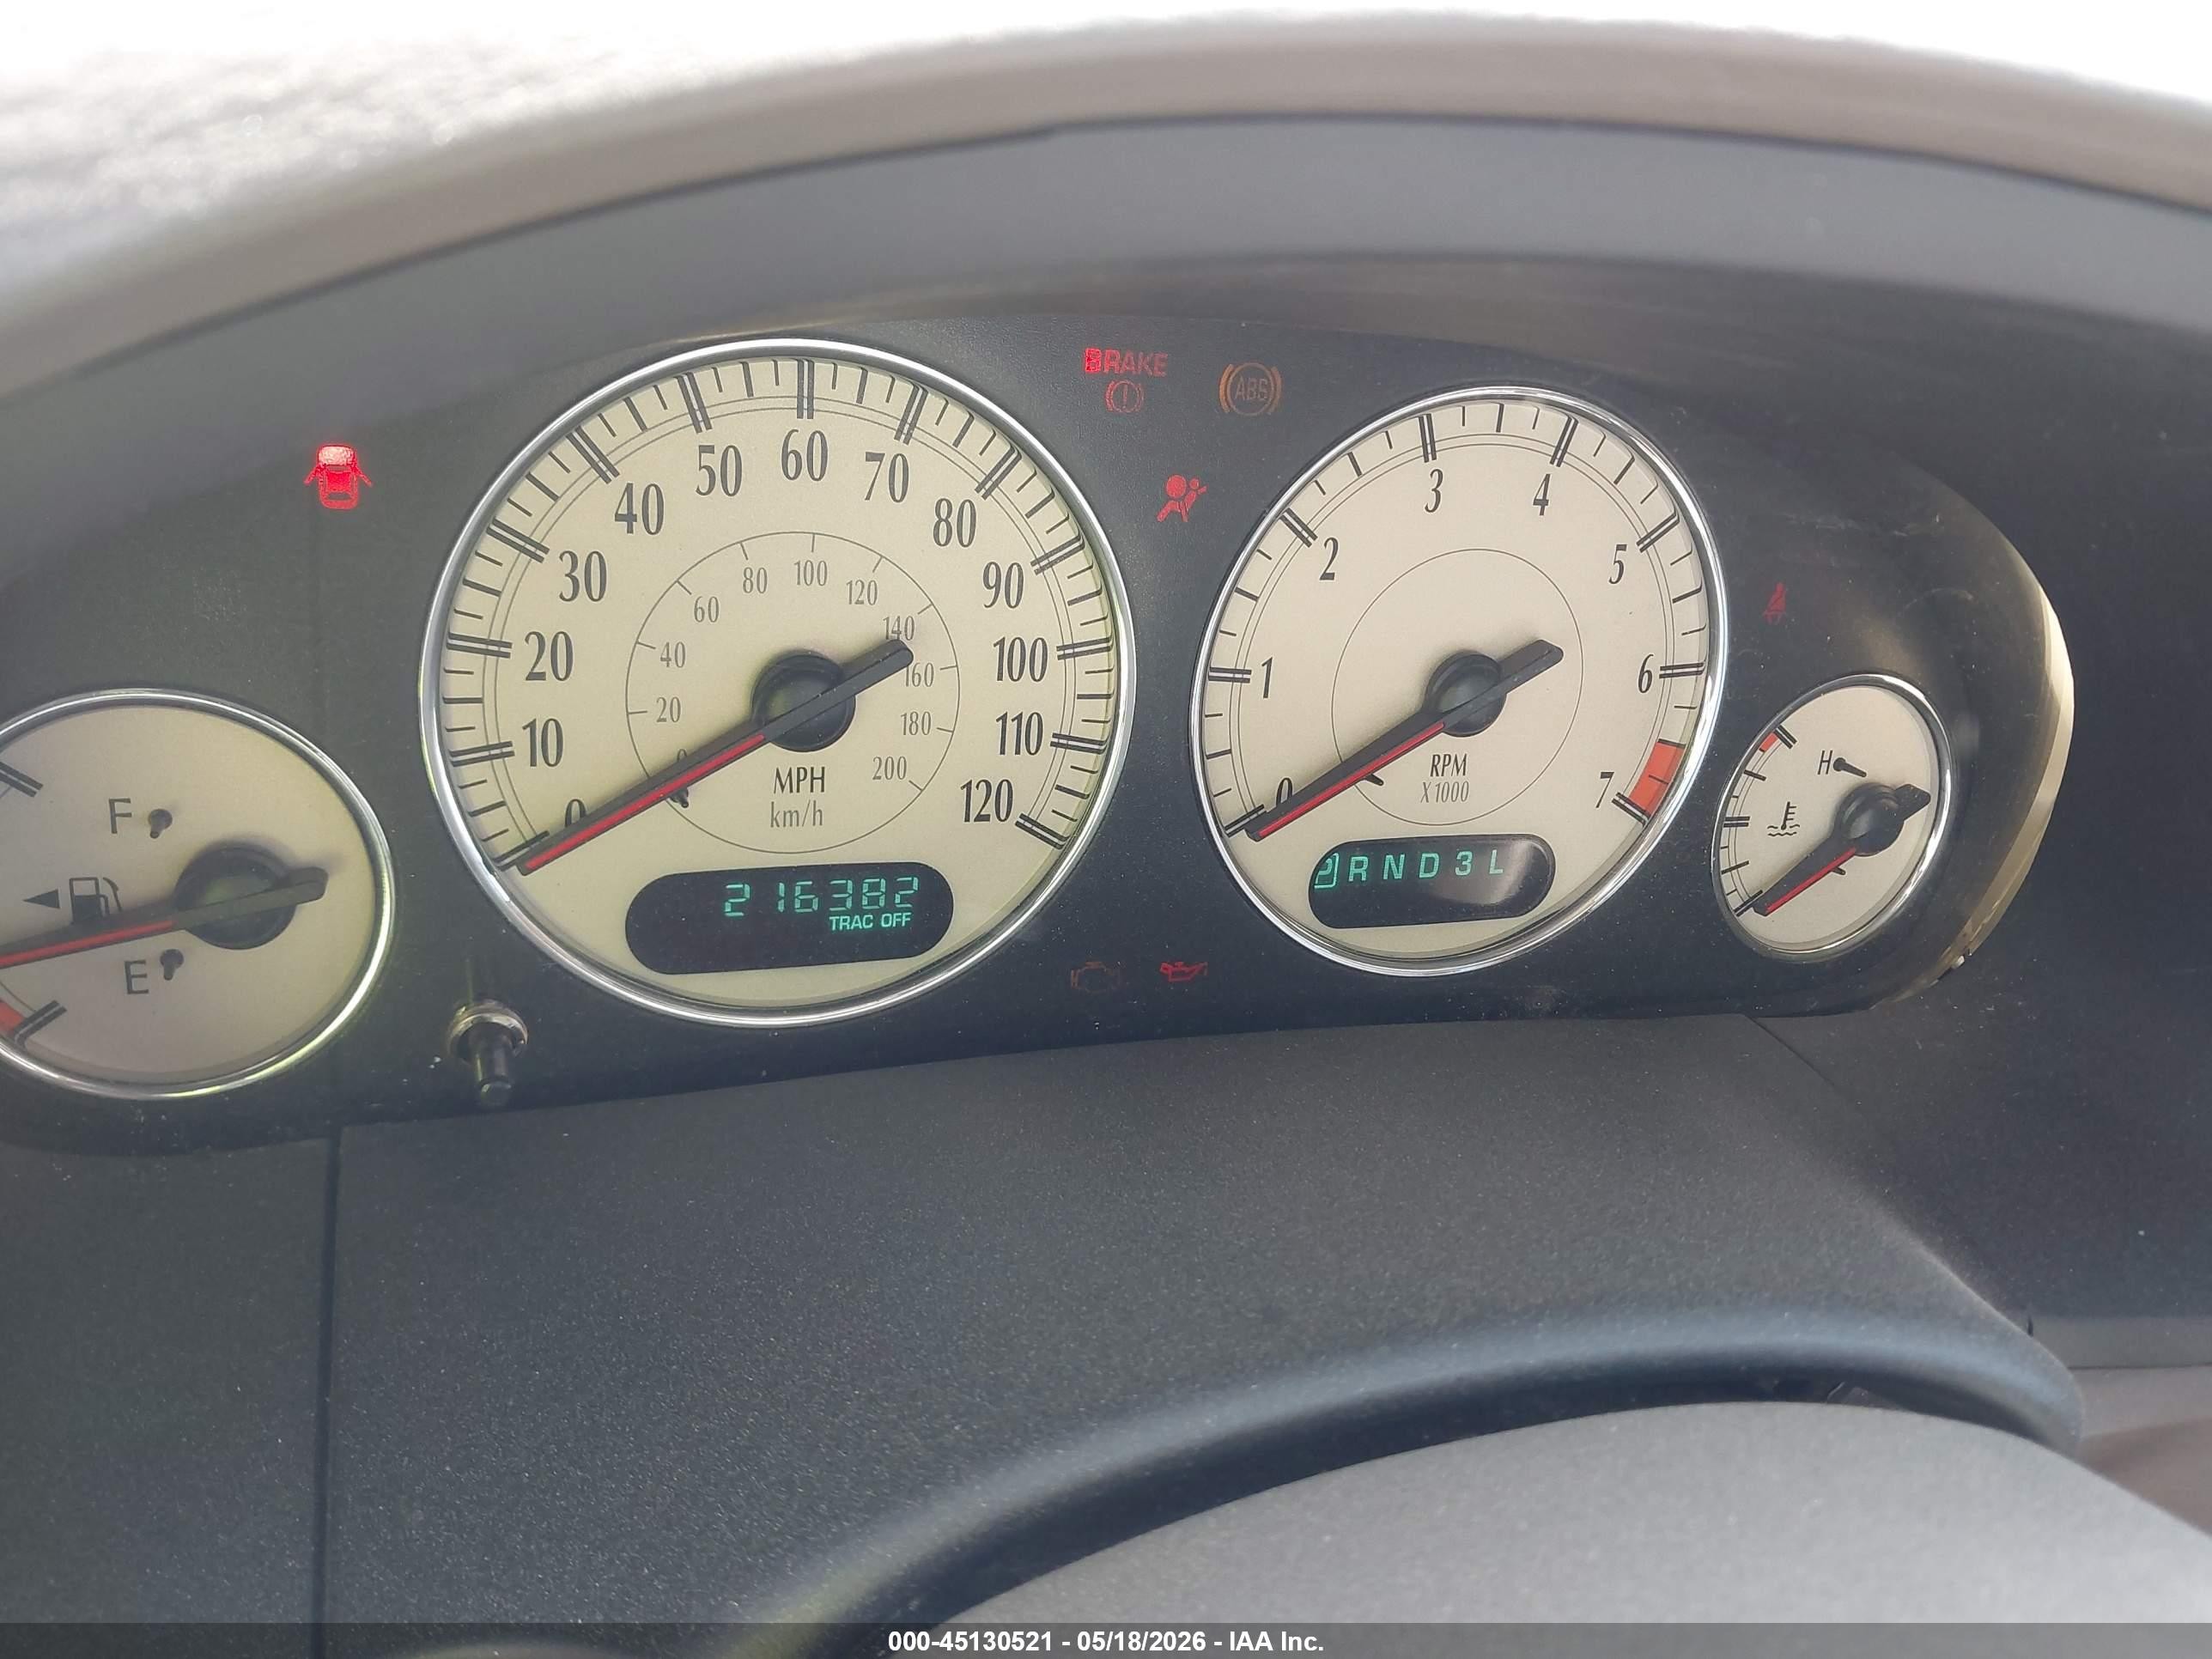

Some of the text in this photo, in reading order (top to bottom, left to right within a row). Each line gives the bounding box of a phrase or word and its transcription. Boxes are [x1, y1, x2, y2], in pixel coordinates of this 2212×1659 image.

[1085, 348, 1168, 376] BRAKE
[696, 445, 743, 496] 50
[781, 429, 828, 481] 60
[865, 452, 909, 503] 70
[1425, 469, 1442, 513] 3
[1533, 473, 1551, 516] 4
[615, 482, 665, 535] 40
[933, 498, 976, 548] 80
[559, 550, 607, 602] 30
[795, 561, 828, 586] 100
[1320, 537, 1340, 580] 2
[1609, 544, 1627, 584] 5
[742, 568, 768, 593] 80
[846, 580, 878, 605] 120
[983, 562, 1024, 609] 90
[694, 598, 720, 623] 60
[883, 616, 915, 641] 140
[526, 631, 574, 681] 20
[659, 642, 685, 667] 40
[994, 635, 1048, 682] 100
[1638, 652, 1654, 693] 6
[906, 662, 934, 687] 160
[1261, 657, 1272, 699] 1
[655, 698, 681, 723] 20
[901, 711, 931, 735] 180
[523, 718, 563, 768] 10
[997, 712, 1042, 756] 110
[774, 767, 825, 793] MPH
[872, 756, 907, 780] 200
[1430, 753, 1468, 777] RPM
[1817, 750, 1832, 775] H
[960, 780, 1013, 823] 120
[1596, 772, 1615, 809] 7
[108, 798, 132, 834] F
[769, 800, 823, 830] km/h
[1348, 856, 1369, 882] R
[1382, 854, 1405, 880] N
[1419, 853, 1439, 878] D
[1455, 851, 1473, 876] 3
[1489, 849, 1504, 874] L
[725, 877, 918, 916] 216382
[830, 912, 912, 931] TRAC OFF
[125, 960, 149, 994] E
